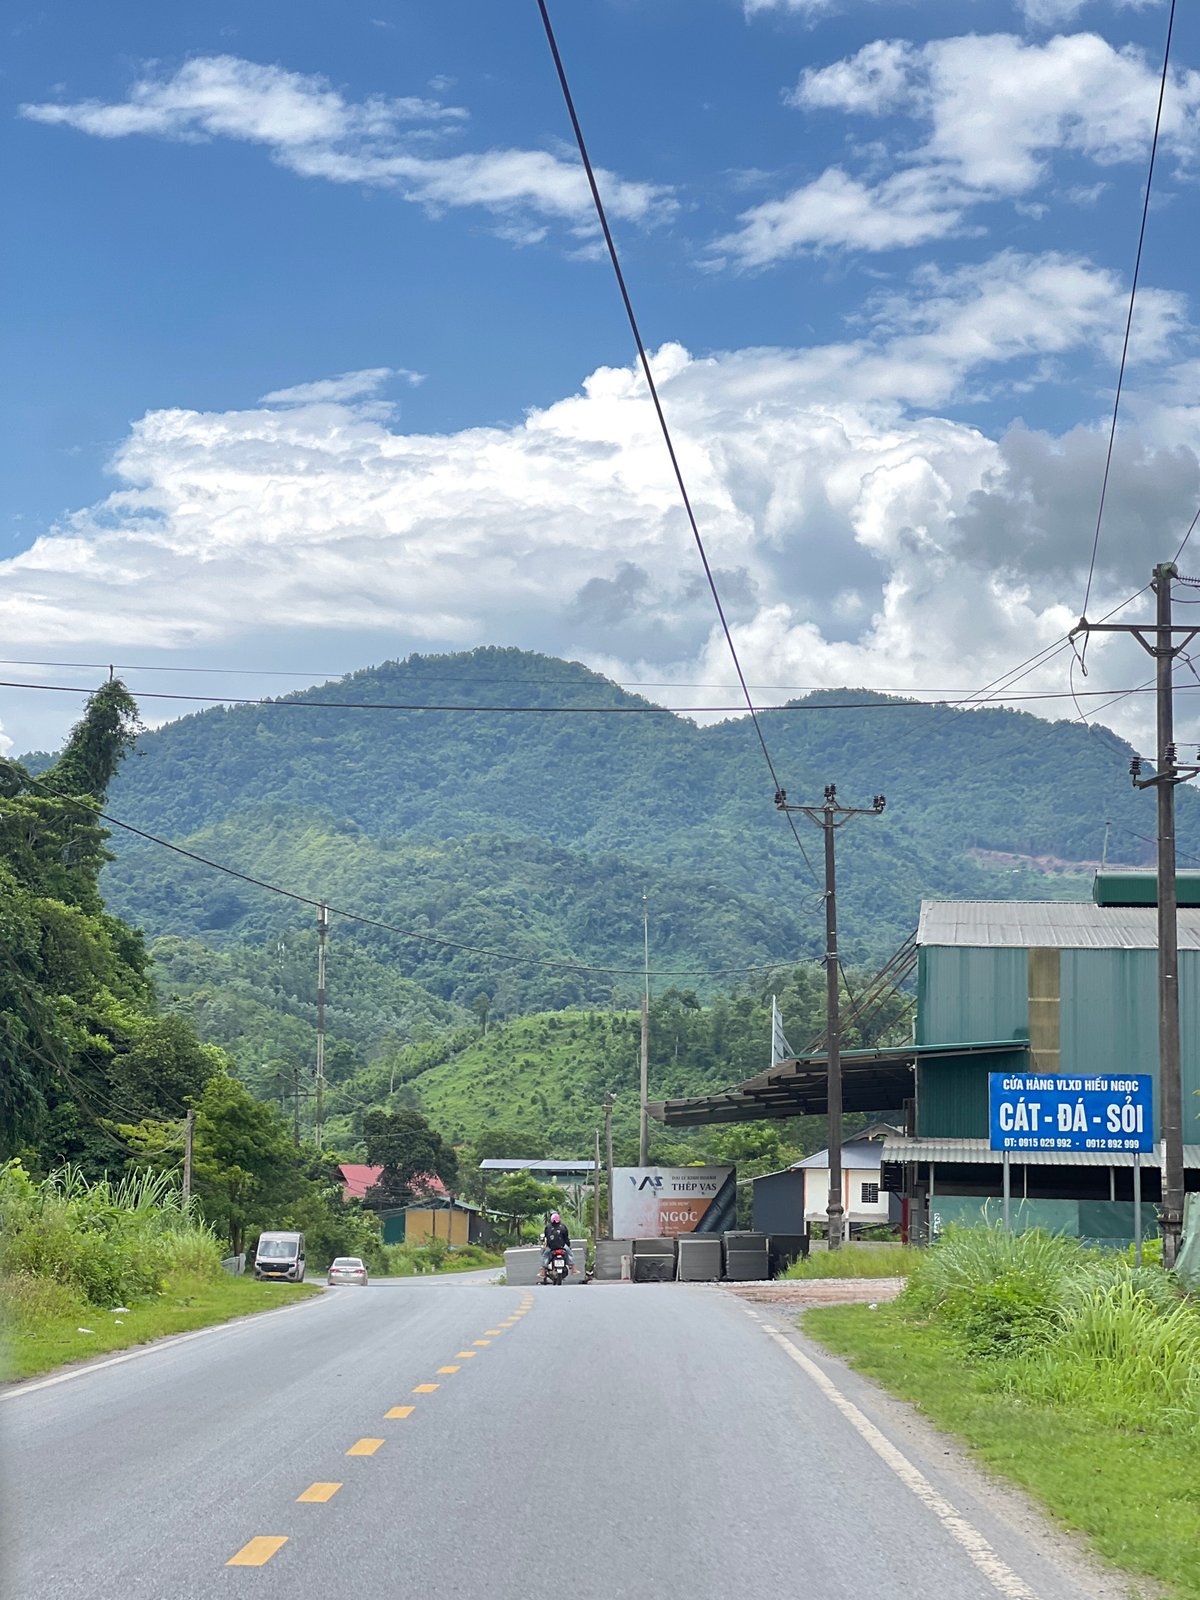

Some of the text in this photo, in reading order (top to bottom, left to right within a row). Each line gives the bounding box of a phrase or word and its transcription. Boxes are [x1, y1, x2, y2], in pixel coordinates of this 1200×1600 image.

[1003, 1075, 1139, 1094] CỬA HÀNG VLXD HIẾU NGỌC
[1000, 1097, 1041, 1131] CÁT
[1057, 1098, 1088, 1132] ĐÁ
[1106, 1096, 1143, 1133] SỎI
[1018, 1137, 1039, 1147] 0915
[1040, 1138, 1055, 1147] 029
[1056, 1138, 1072, 1148] 992
[1085, 1138, 1106, 1148] 0912
[1107, 1139, 1123, 1149] 892
[1124, 1139, 1140, 1149] 999
[671, 1181, 717, 1191] THÉP VAS
[660, 1211, 698, 1225] NGỌC
